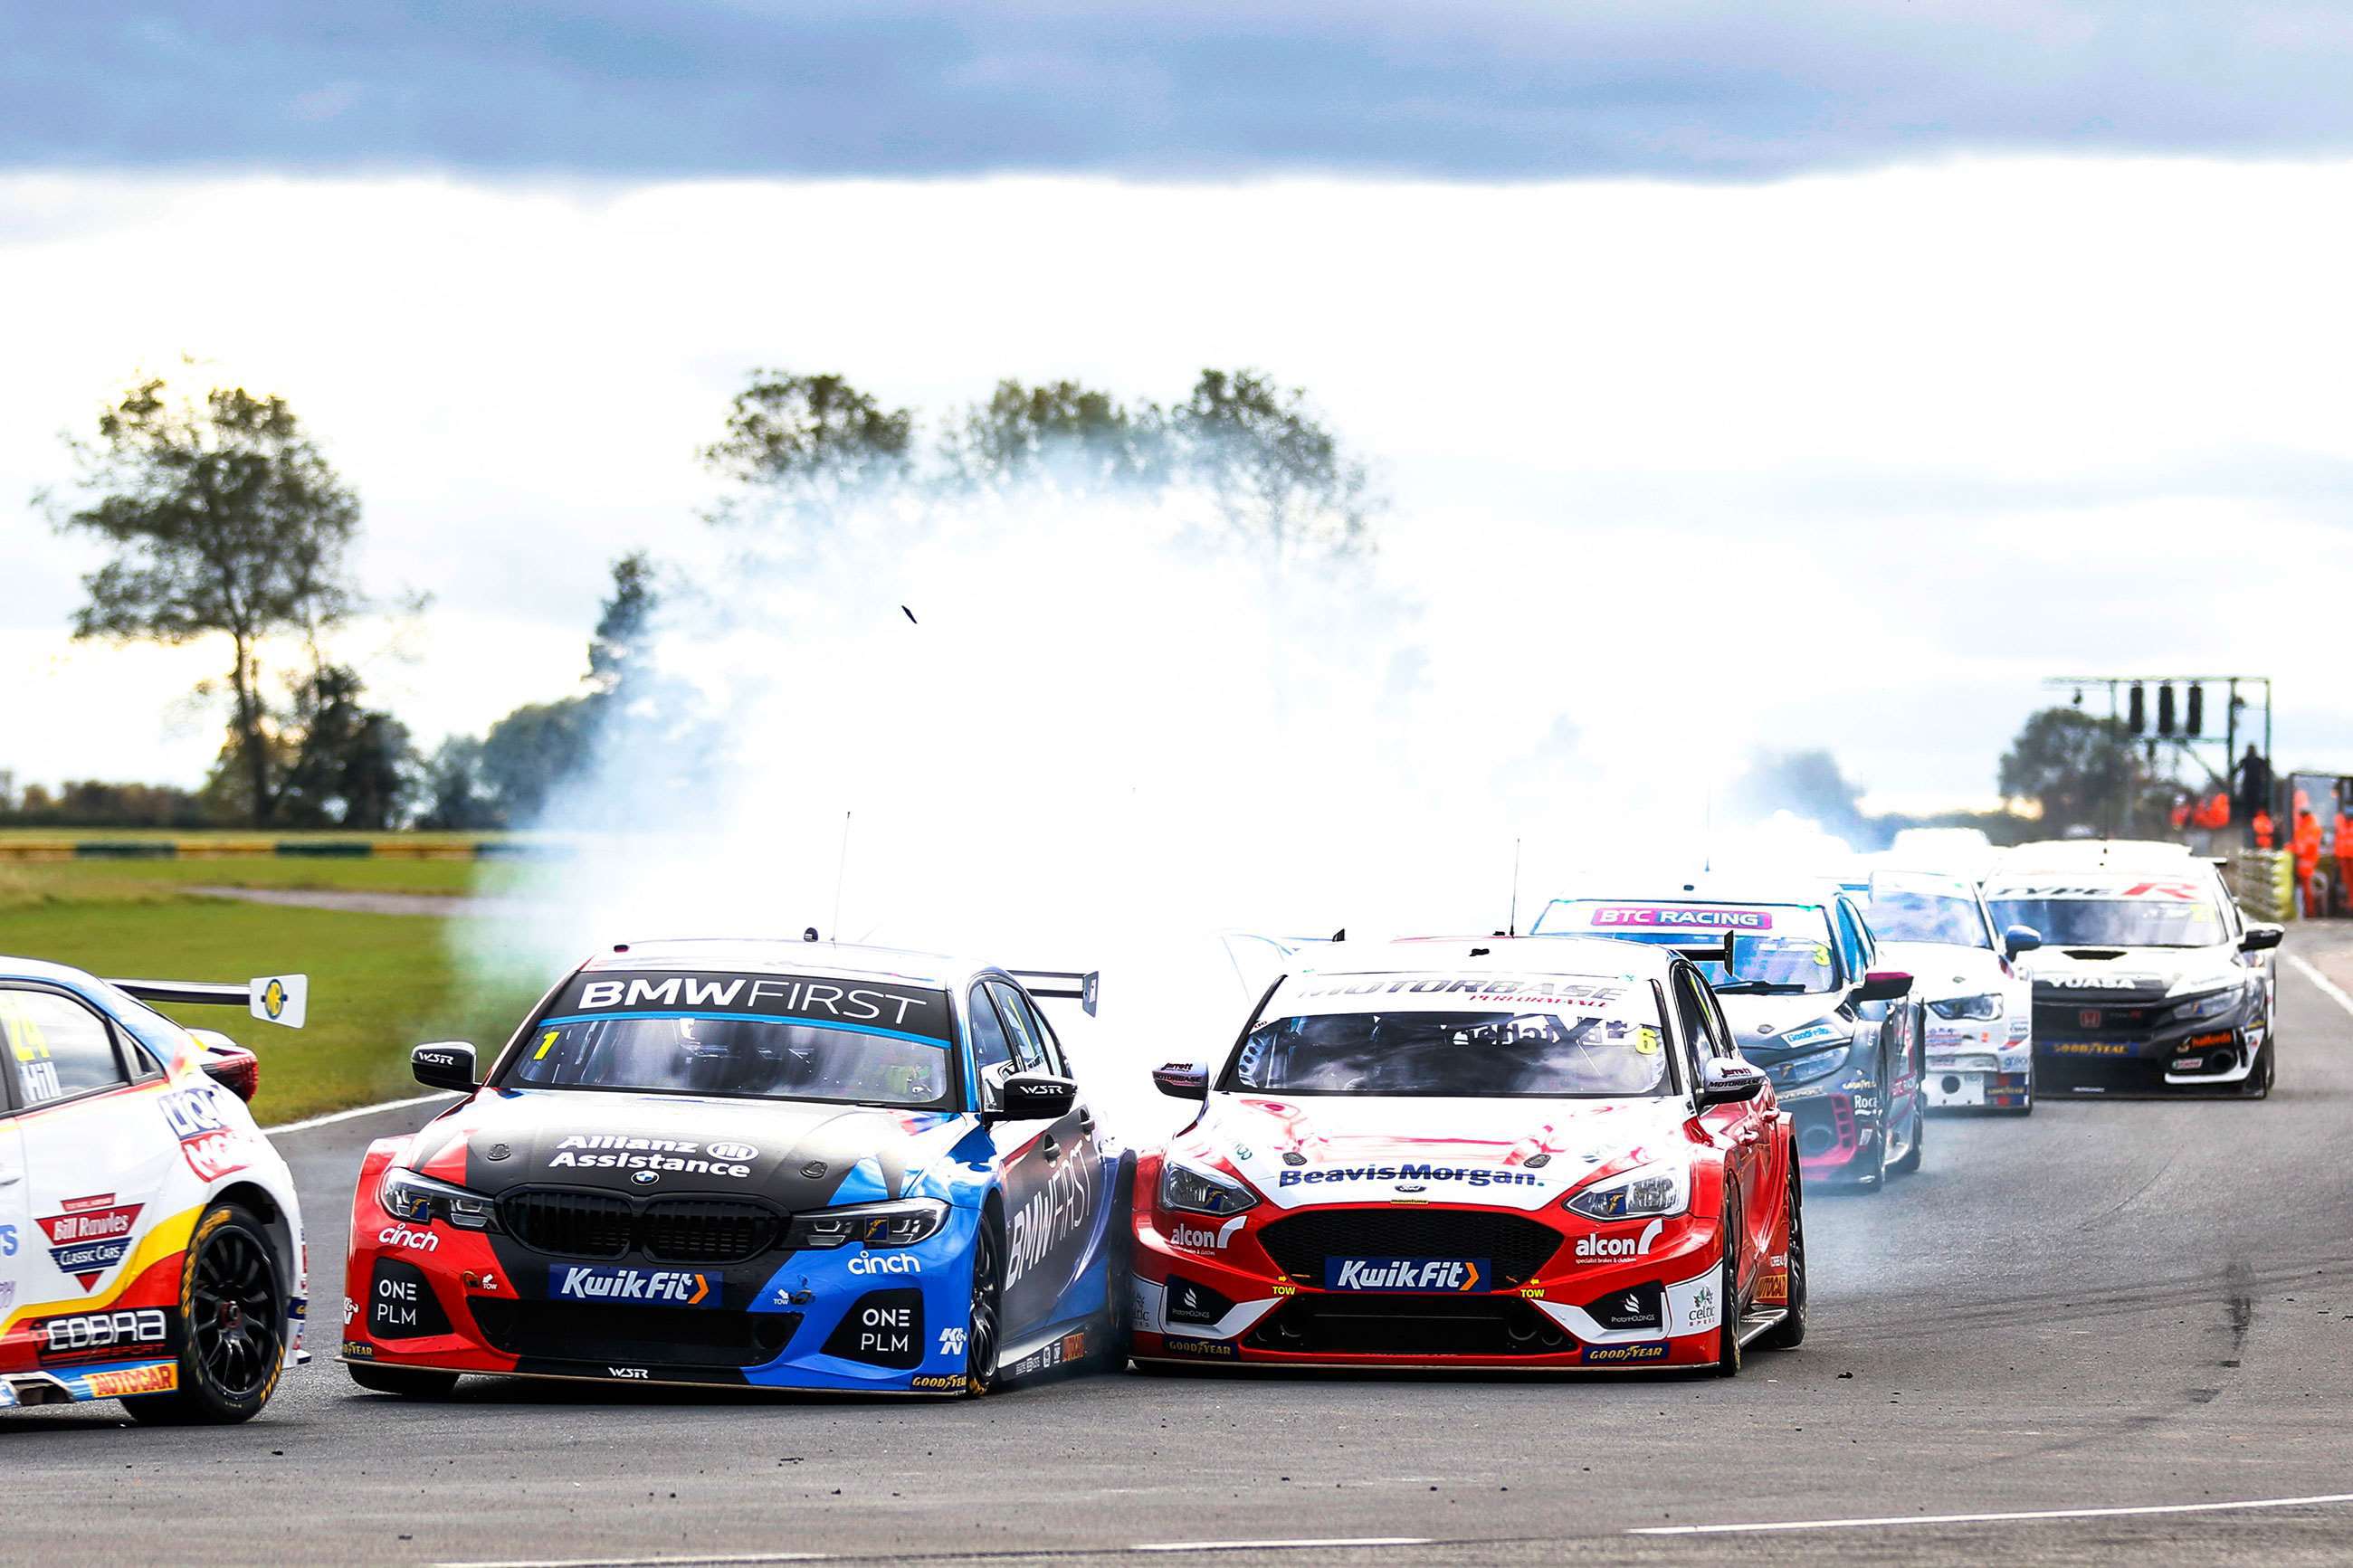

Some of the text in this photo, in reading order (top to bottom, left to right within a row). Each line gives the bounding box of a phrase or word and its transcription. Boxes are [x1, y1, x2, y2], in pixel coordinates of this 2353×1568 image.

[2120, 882, 2199, 900] R
[1598, 909, 1759, 927] BTC RACING
[1814, 945, 1832, 966] 3
[2046, 977, 2136, 990] YUASA
[533, 1031, 560, 1060] 1
[1634, 1028, 1659, 1055] 6
[418, 1051, 454, 1066] WSR
[20, 1061, 62, 1102] Hill
[1020, 1085, 1063, 1095] WSR
[556, 1135, 700, 1154] Allianz
[548, 1152, 751, 1178] Assistance
[52, 1216, 78, 1241] Bill
[79, 1212, 130, 1238] Rawles
[378, 1222, 440, 1252] cinch
[1170, 1223, 1215, 1249] alcon
[1575, 1232, 1635, 1257] alcon
[847, 1250, 921, 1275] cinch
[378, 1278, 417, 1301] ONE
[482, 1282, 498, 1290] TOW
[1272, 1286, 1296, 1295] TOW
[1520, 1288, 1545, 1297] TOW
[376, 1304, 417, 1326] PLM
[862, 1307, 910, 1327] ONE
[861, 1333, 909, 1353] PLM
[1588, 1345, 1663, 1360] GOODYEAR
[96, 1365, 173, 1395] AUTOCAR
[608, 1366, 649, 1379] WSR
[911, 1374, 967, 1390] GOODYEA
